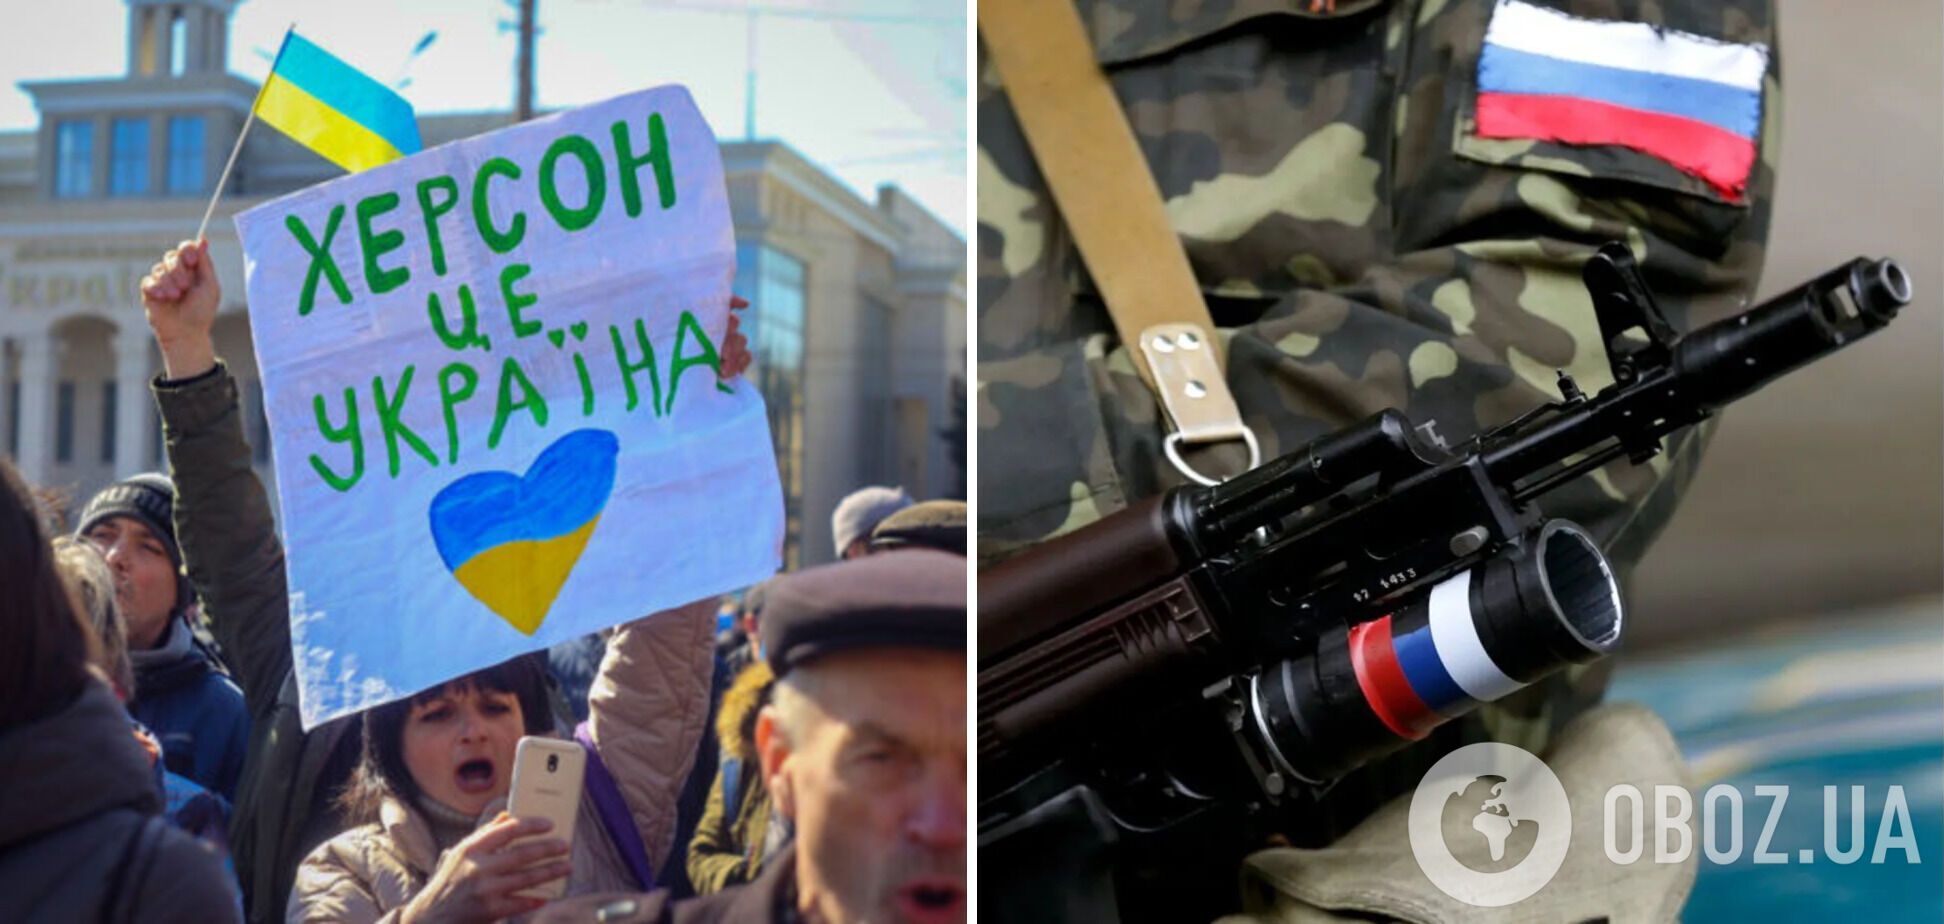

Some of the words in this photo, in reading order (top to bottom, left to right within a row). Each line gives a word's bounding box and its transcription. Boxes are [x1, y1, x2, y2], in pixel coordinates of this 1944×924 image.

[285, 112, 677, 316] ХЕРСОН
[427, 264, 543, 351] ЦЕ
[309, 310, 735, 492] УКРАЇНА
